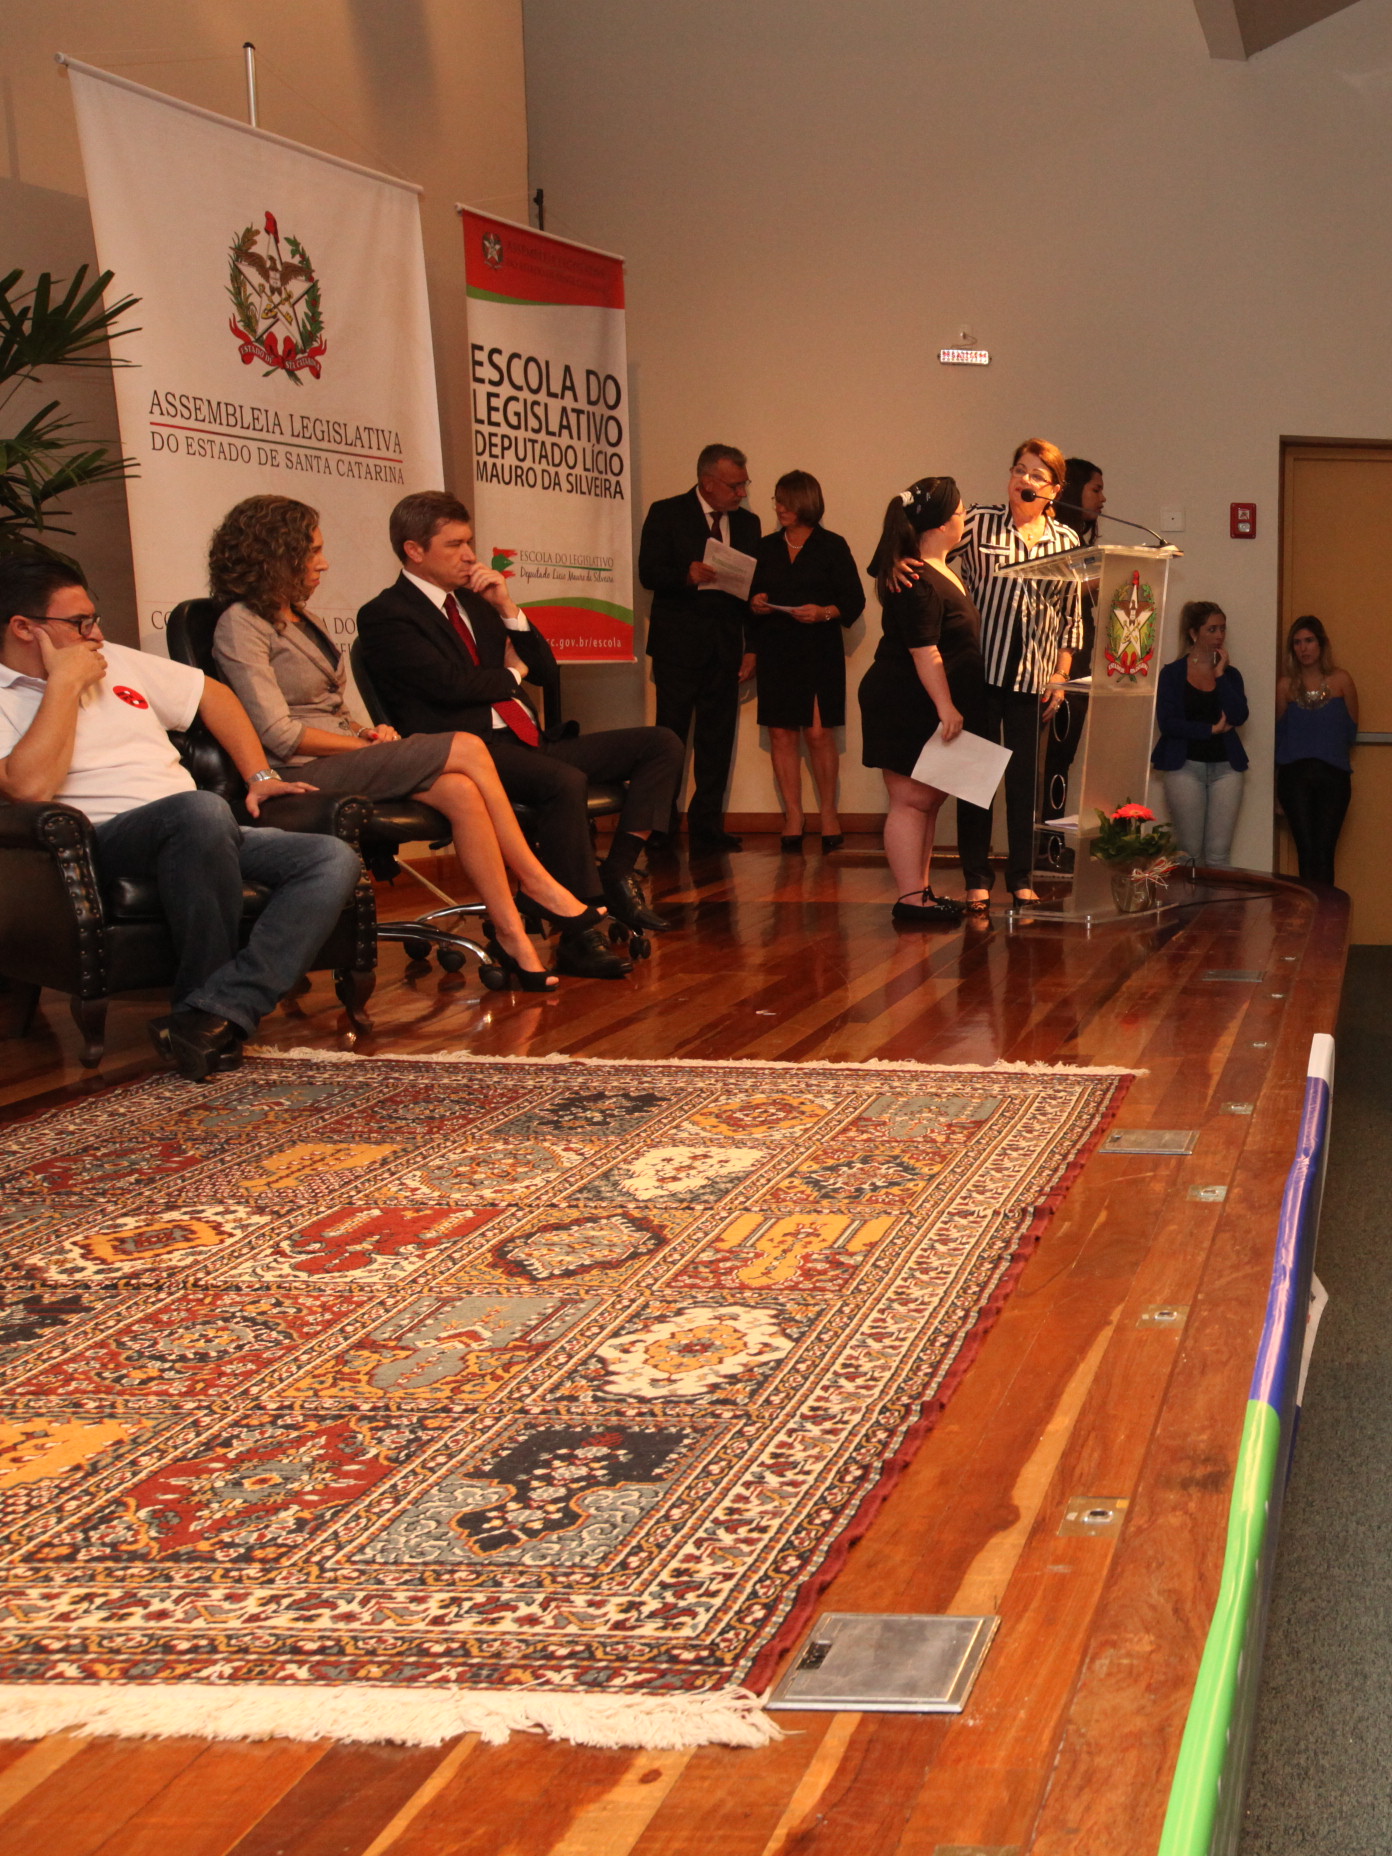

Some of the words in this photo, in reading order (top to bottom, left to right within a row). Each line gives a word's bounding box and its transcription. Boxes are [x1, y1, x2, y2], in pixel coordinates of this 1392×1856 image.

[470, 342, 579, 403] ESCOLA
[585, 368, 622, 411] DO
[149, 389, 285, 436] ASSEMBLEIA
[288, 413, 403, 454] LEGISLATIVA
[472, 388, 623, 448] LEGISLATIVO
[150, 431, 180, 454] DO
[185, 435, 252, 464] ESTADO
[257, 446, 280, 468] DE
[285, 450, 333, 476] SANTA
[336, 458, 405, 485] CATARINA
[474, 429, 578, 470] DEPUTADO
[582, 443, 625, 477] LÍCIO
[476, 459, 538, 488] MAURO
[541, 468, 563, 492] DA
[566, 472, 625, 500] SILVEIRA
[519, 550, 552, 563] ESCOLA
[555, 553, 568, 564] DO
[569, 554, 614, 568] LEGISLATIVO
[520, 566, 551, 584] Deputado
